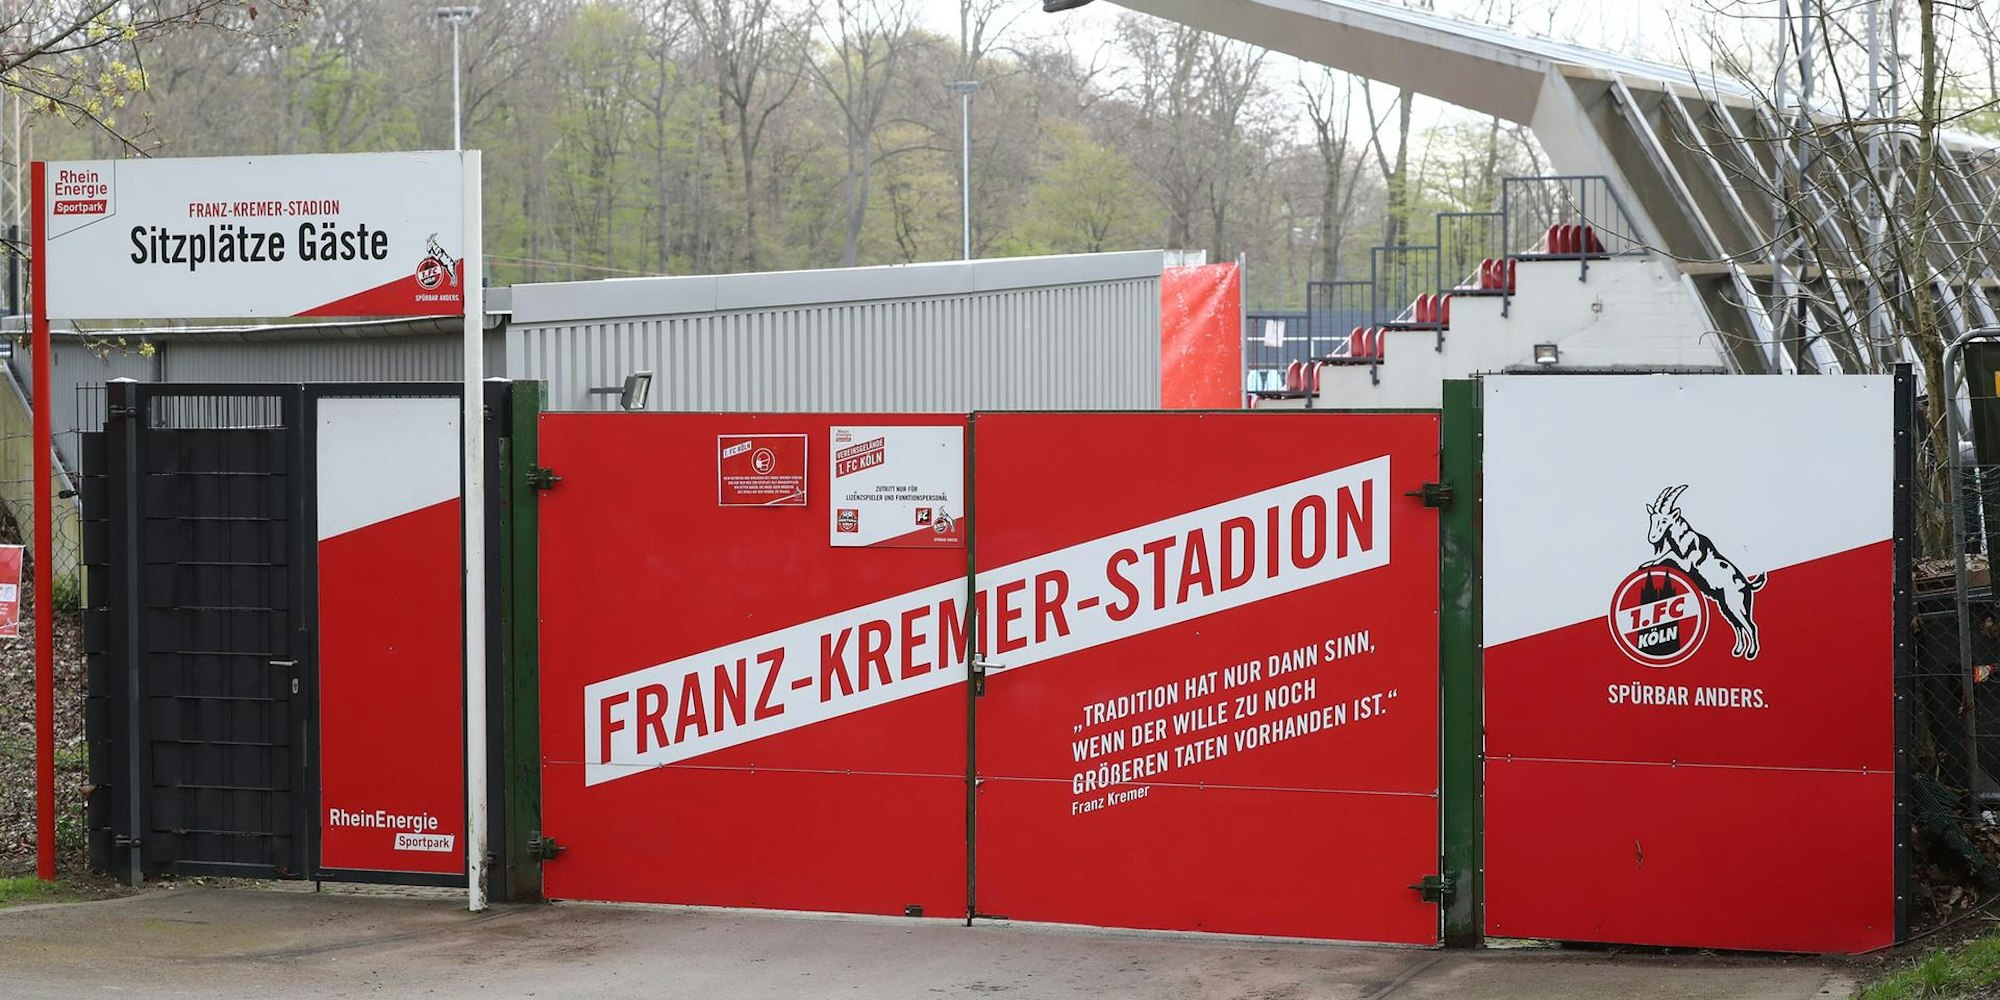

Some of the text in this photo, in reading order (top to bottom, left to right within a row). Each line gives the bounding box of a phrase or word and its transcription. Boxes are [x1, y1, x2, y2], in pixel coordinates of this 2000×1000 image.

[60, 170, 98, 183] Rhein
[55, 183, 107, 198] Energie
[57, 202, 103, 213] Sportpark
[189, 199, 340, 217] FRANZ-KREMER-STADION
[130, 222, 388, 271] Sitzplätze Gäste
[846, 459, 858, 473] FC
[860, 452, 883, 469] KÖLN
[875, 484, 918, 493] ZUTRITT NUR FÜR
[600, 478, 1374, 765] FRANZ-KREMER-STADION
[1630, 597, 1686, 630] 1.FC
[1638, 625, 1678, 649] KÖLN
[1185, 672, 1217, 700] HAT
[1224, 660, 1262, 689] NUR
[1268, 644, 1318, 678] DANN
[1325, 629, 1376, 663] SINN,
[1607, 681, 1769, 709] SPÜRBAR ANDERS.
[1072, 678, 1317, 763] WENN DER WILLE ZU NOCH
[1174, 737, 1228, 768] TATEN
[1234, 703, 1347, 751] VORHANDEN
[1072, 784, 1150, 816] Franz Kremer
[329, 808, 438, 833] RheinEnergie
[399, 836, 450, 850] Sportpark
